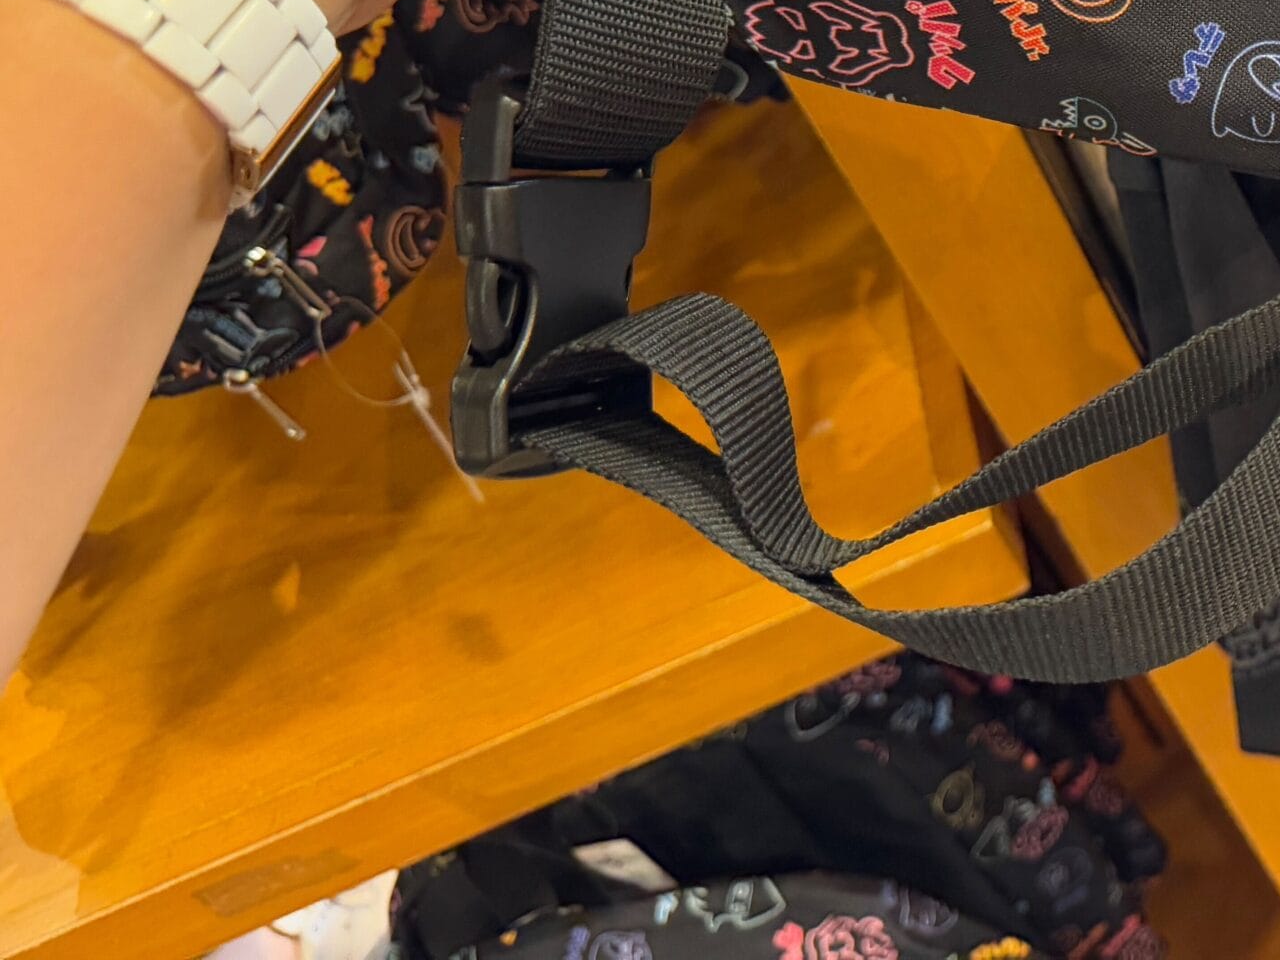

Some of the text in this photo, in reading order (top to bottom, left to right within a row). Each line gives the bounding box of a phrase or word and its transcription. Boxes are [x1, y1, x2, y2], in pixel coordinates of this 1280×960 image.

[904, 0, 977, 90] クッパ
[1168, 21, 1227, 105] テレサ
